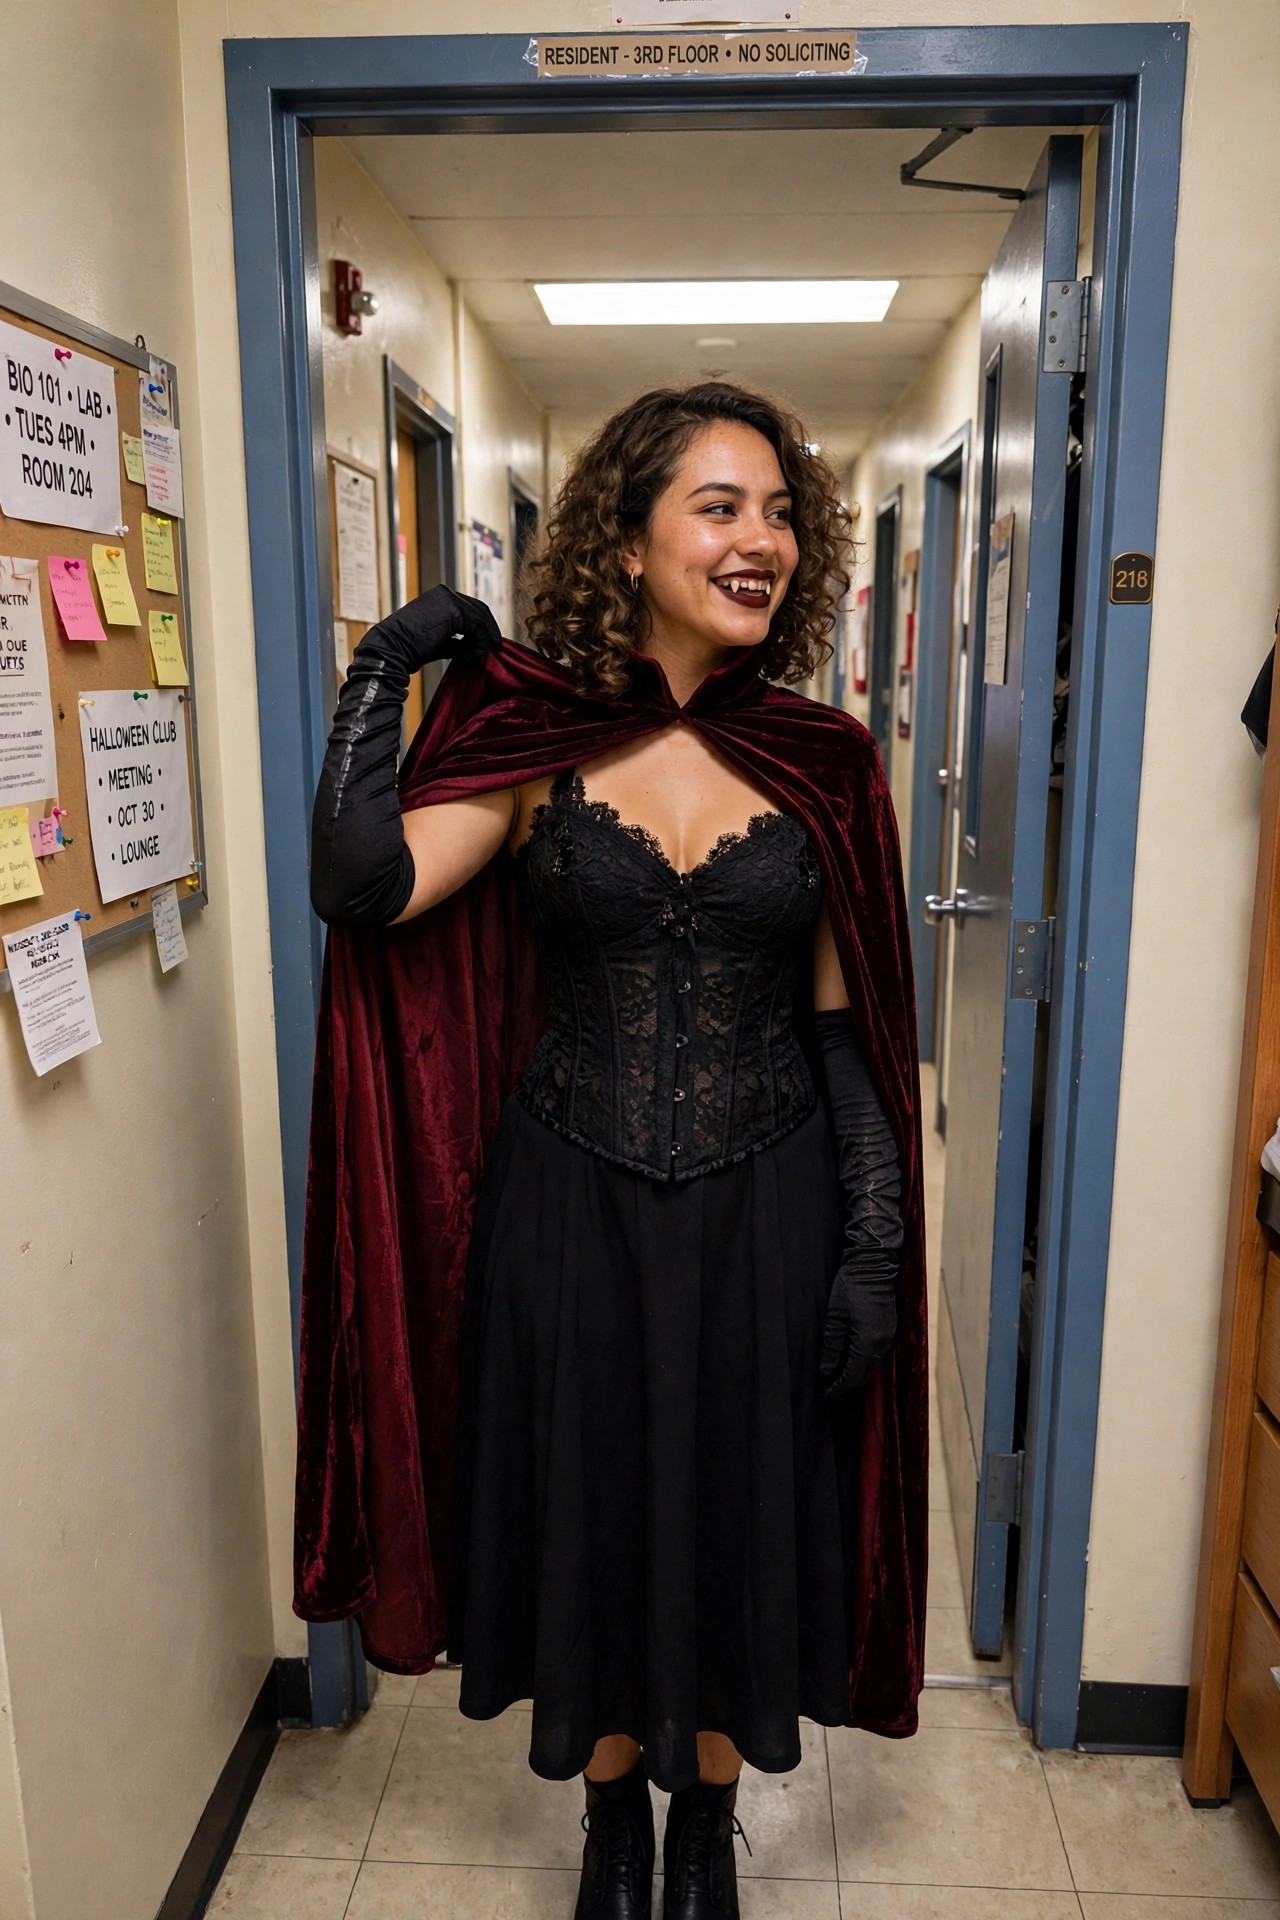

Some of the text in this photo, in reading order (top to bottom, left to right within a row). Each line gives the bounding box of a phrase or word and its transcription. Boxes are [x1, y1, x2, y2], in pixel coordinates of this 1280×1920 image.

[545, 46, 620, 66] RESIDENT
[633, 45, 664, 65] 3RD
[668, 44, 719, 64] FLOOR
[738, 43, 761, 63] NO
[765, 42, 850, 63] SOLICITING
[6, 359, 34, 397] BIO
[38, 371, 62, 407] 101
[76, 385, 103, 419] LAB
[14, 406, 87, 456] TUES 4PM
[21, 453, 93, 499] ROOM 204
[1115, 570, 1148, 588] 218
[89, 720, 177, 753] HALLOWEEN CLUB
[108, 763, 153, 792] MEETING
[117, 800, 155, 828] OCT 30
[120, 834, 161, 865] LOUNGE
